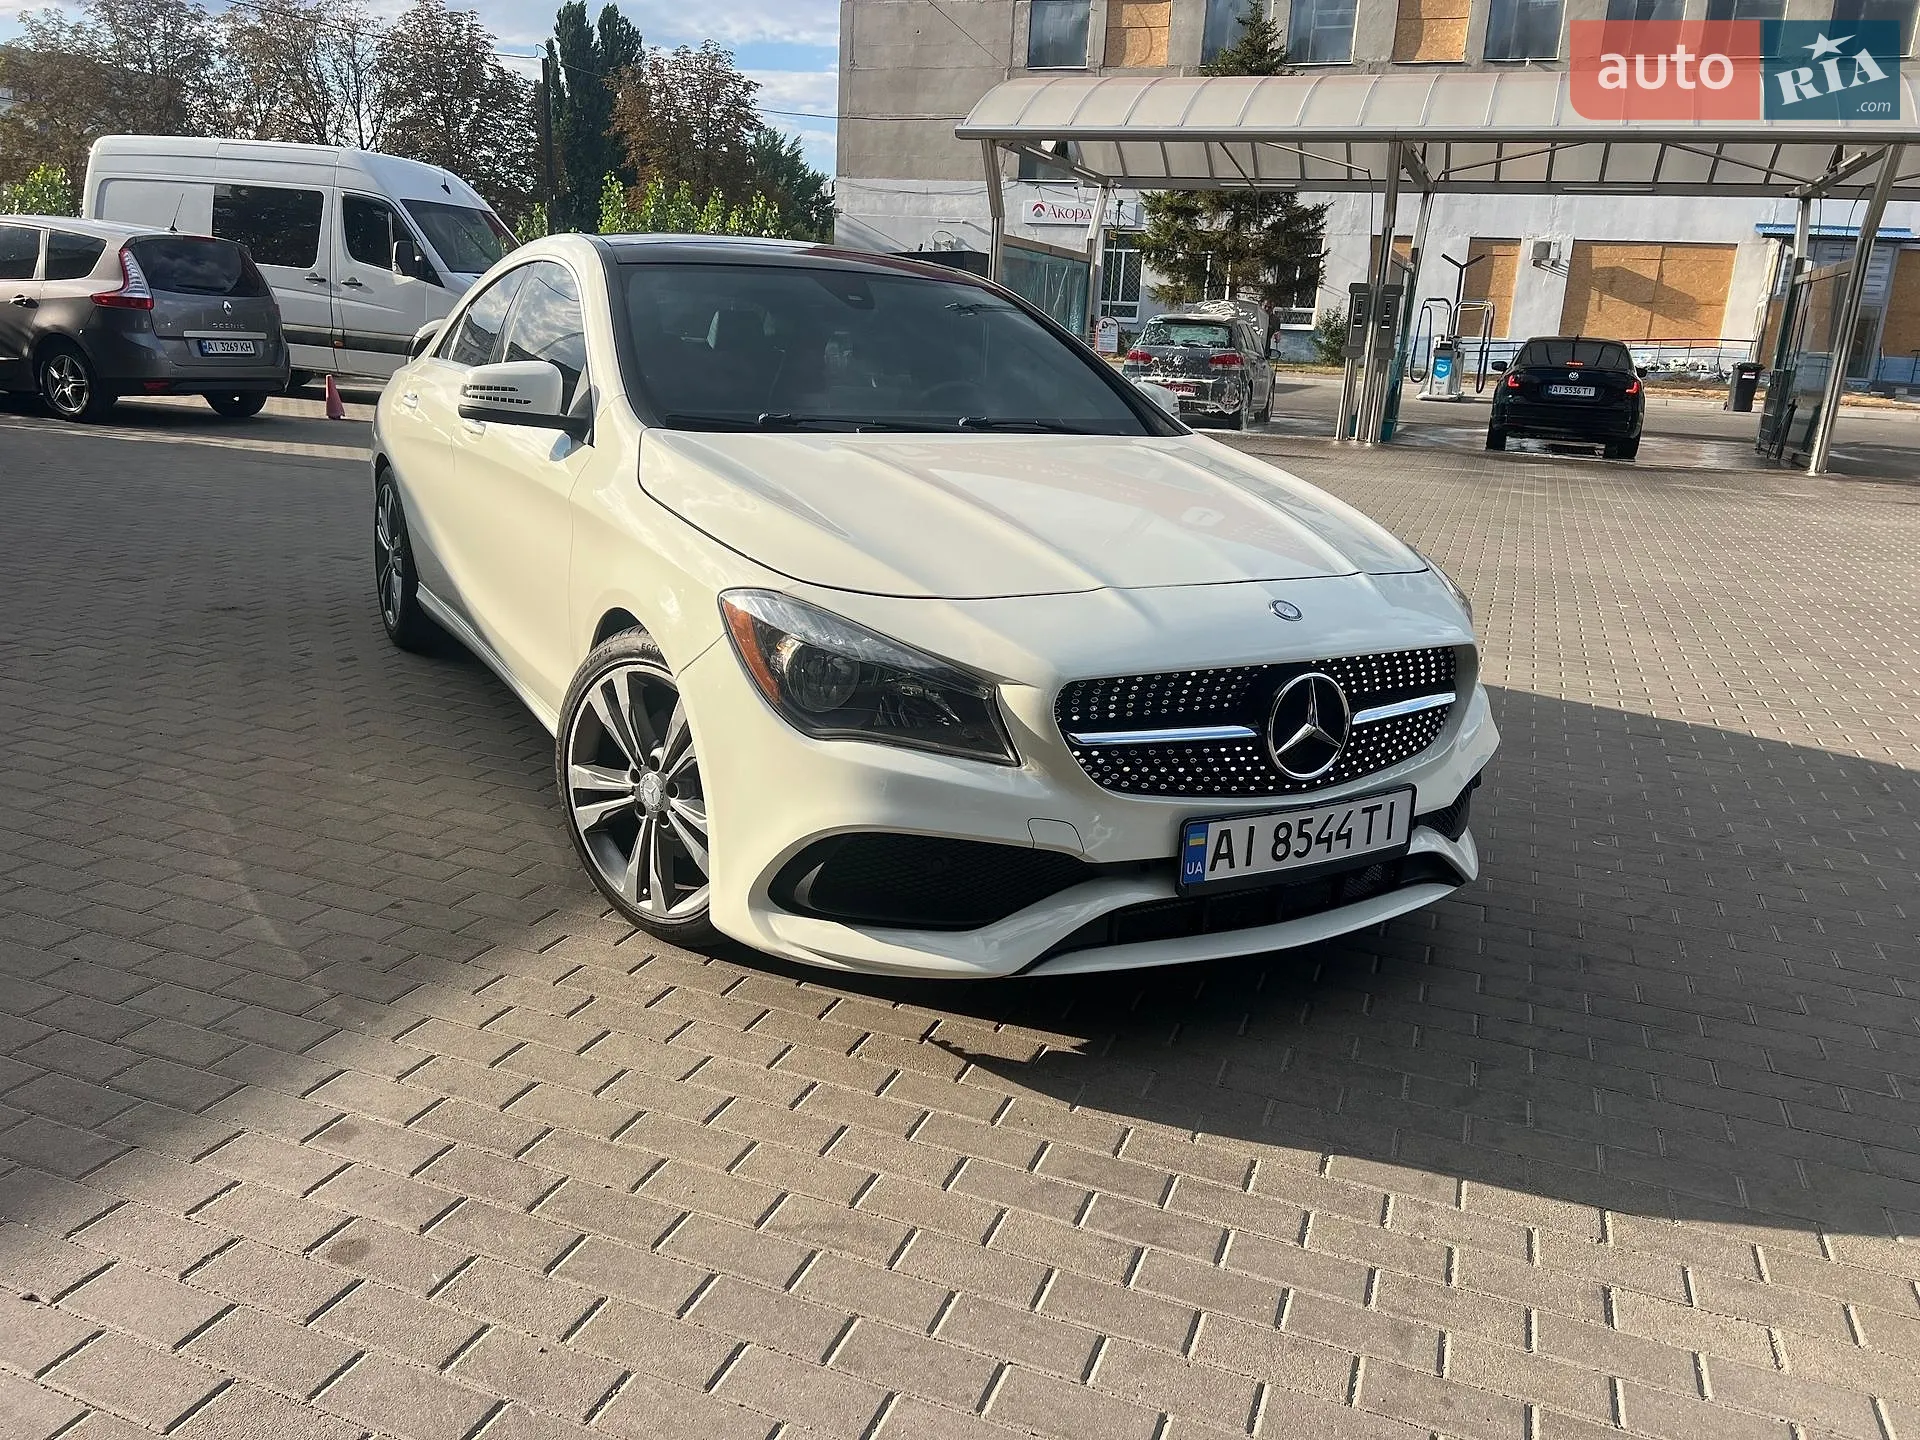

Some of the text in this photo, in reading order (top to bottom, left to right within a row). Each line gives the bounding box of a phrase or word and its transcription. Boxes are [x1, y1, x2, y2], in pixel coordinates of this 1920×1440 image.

[208, 341, 252, 352] AI 3269 KH
[1552, 385, 1562, 393] AI
[1209, 801, 1395, 872] AI 8544 TI
[1186, 861, 1203, 875] UA
